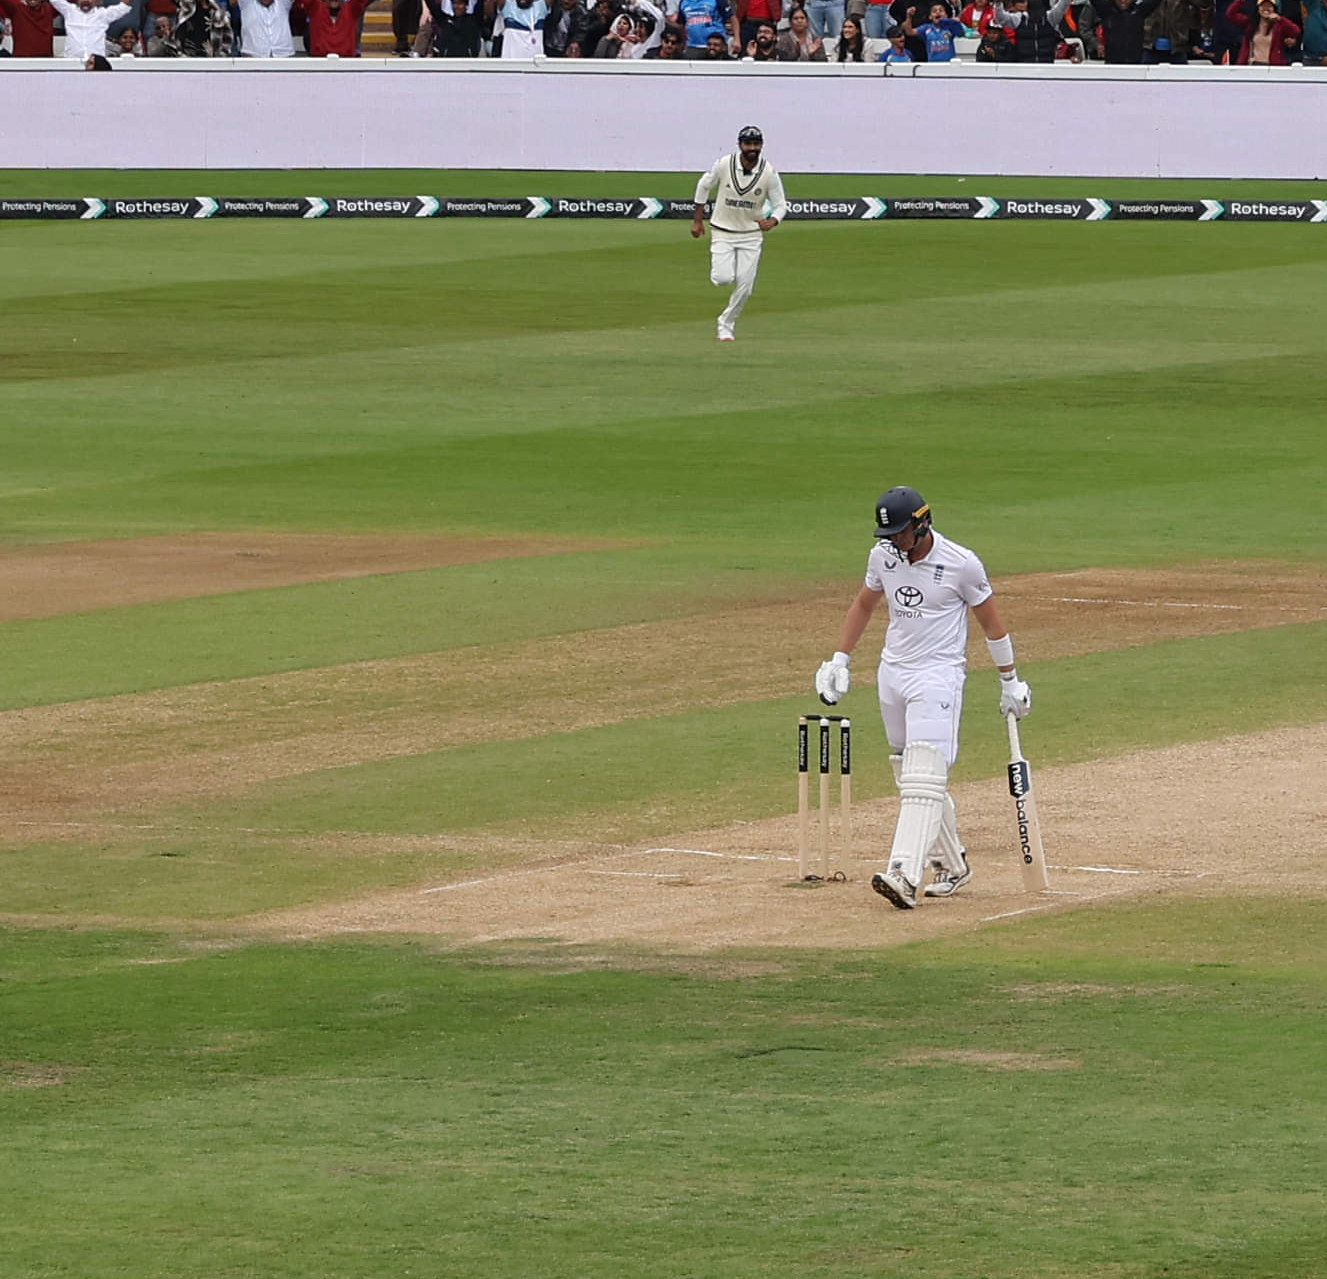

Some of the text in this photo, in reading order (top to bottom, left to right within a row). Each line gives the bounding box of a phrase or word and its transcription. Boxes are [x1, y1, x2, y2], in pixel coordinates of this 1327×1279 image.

[2, 202, 76, 212] Protecting Pensions
[116, 201, 189, 214] Rothesay
[225, 202, 299, 212] Protecting Pensions
[337, 200, 410, 213] Rothesay
[447, 202, 521, 212] Protecting Pensions
[559, 200, 633, 214] Rothesay
[670, 202, 713, 212] Protecg
[785, 201, 856, 215] Rothesay
[895, 201, 969, 211] Protecting Pensions
[1008, 201, 1081, 217] Rothesay
[1120, 204, 1194, 214] Protecting Pensions
[1232, 203, 1305, 218] Rothesay
[1011, 763, 1033, 865] new balance
